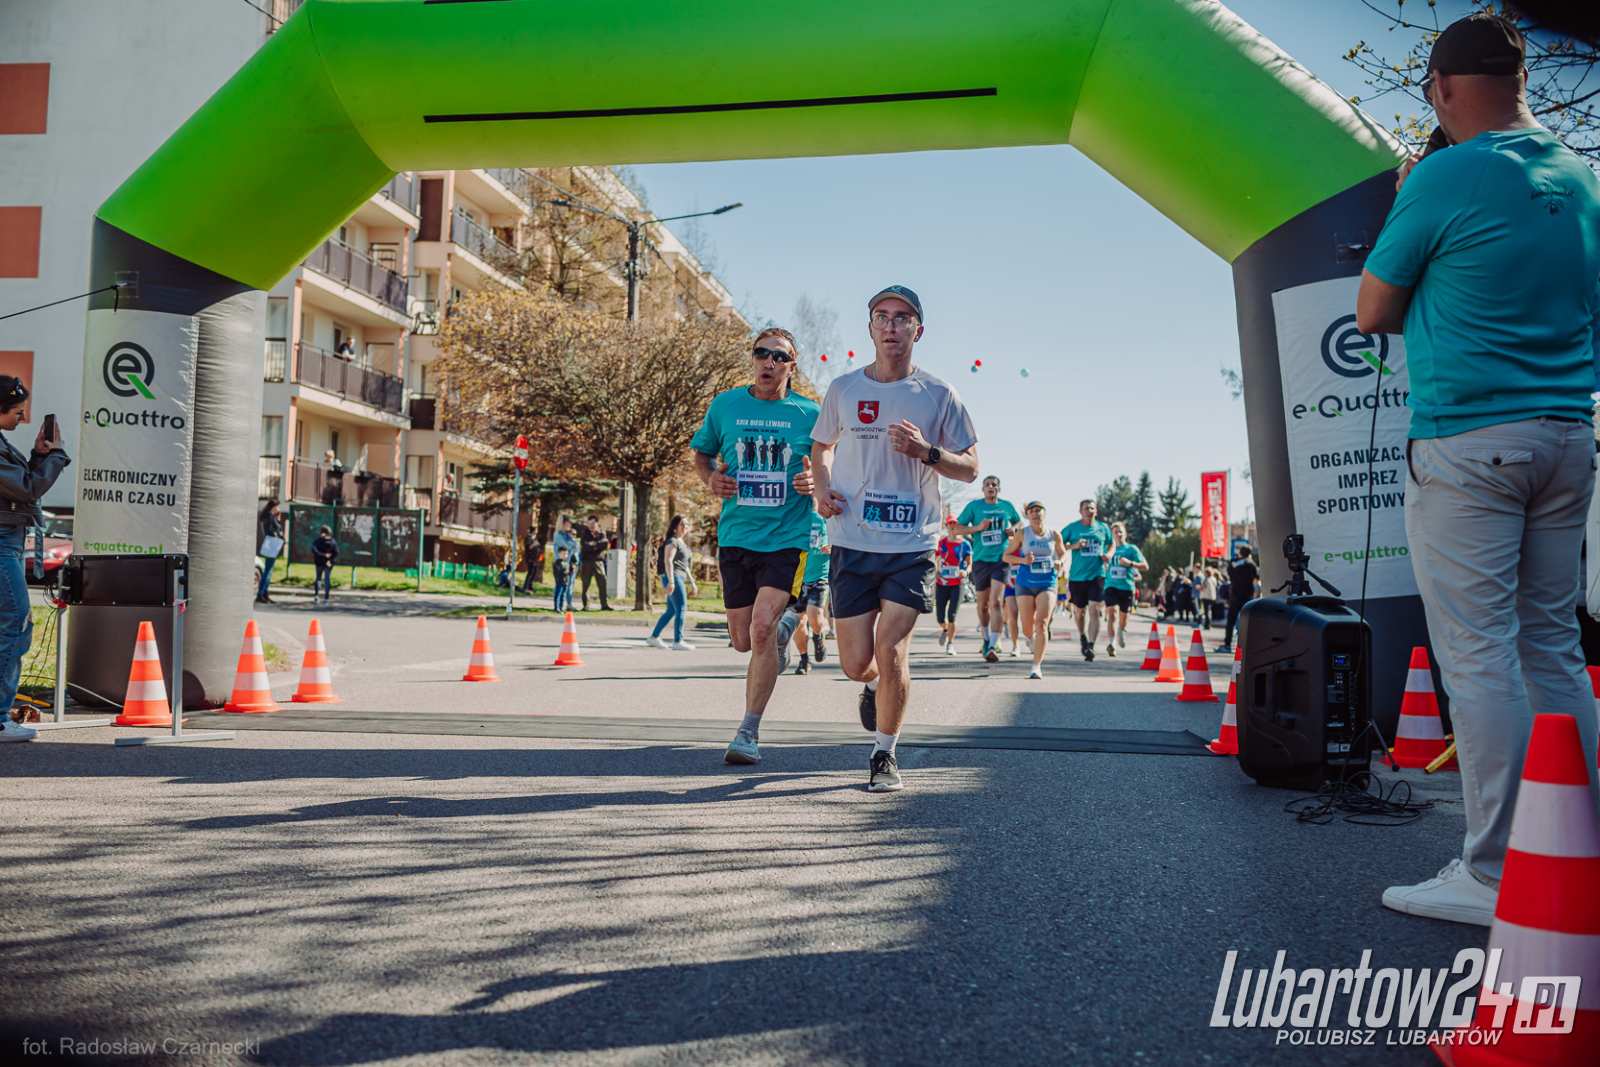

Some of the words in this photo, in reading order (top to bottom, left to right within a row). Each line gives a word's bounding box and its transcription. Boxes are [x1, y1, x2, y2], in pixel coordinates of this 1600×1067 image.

[1310, 446, 1405, 469] ORGANIZAC
[83, 468, 177, 487] ELEKTRONICZNY
[1338, 469, 1399, 489] IMPREZ
[83, 488, 123, 503] POMIAR
[128, 491, 176, 507] CZASU
[759, 483, 780, 497] 111
[887, 504, 914, 522] 167
[1317, 492, 1405, 515] SPORTOWY
[84, 541, 164, 556] e-quattro.pl
[1324, 545, 1409, 564] e-quattro
